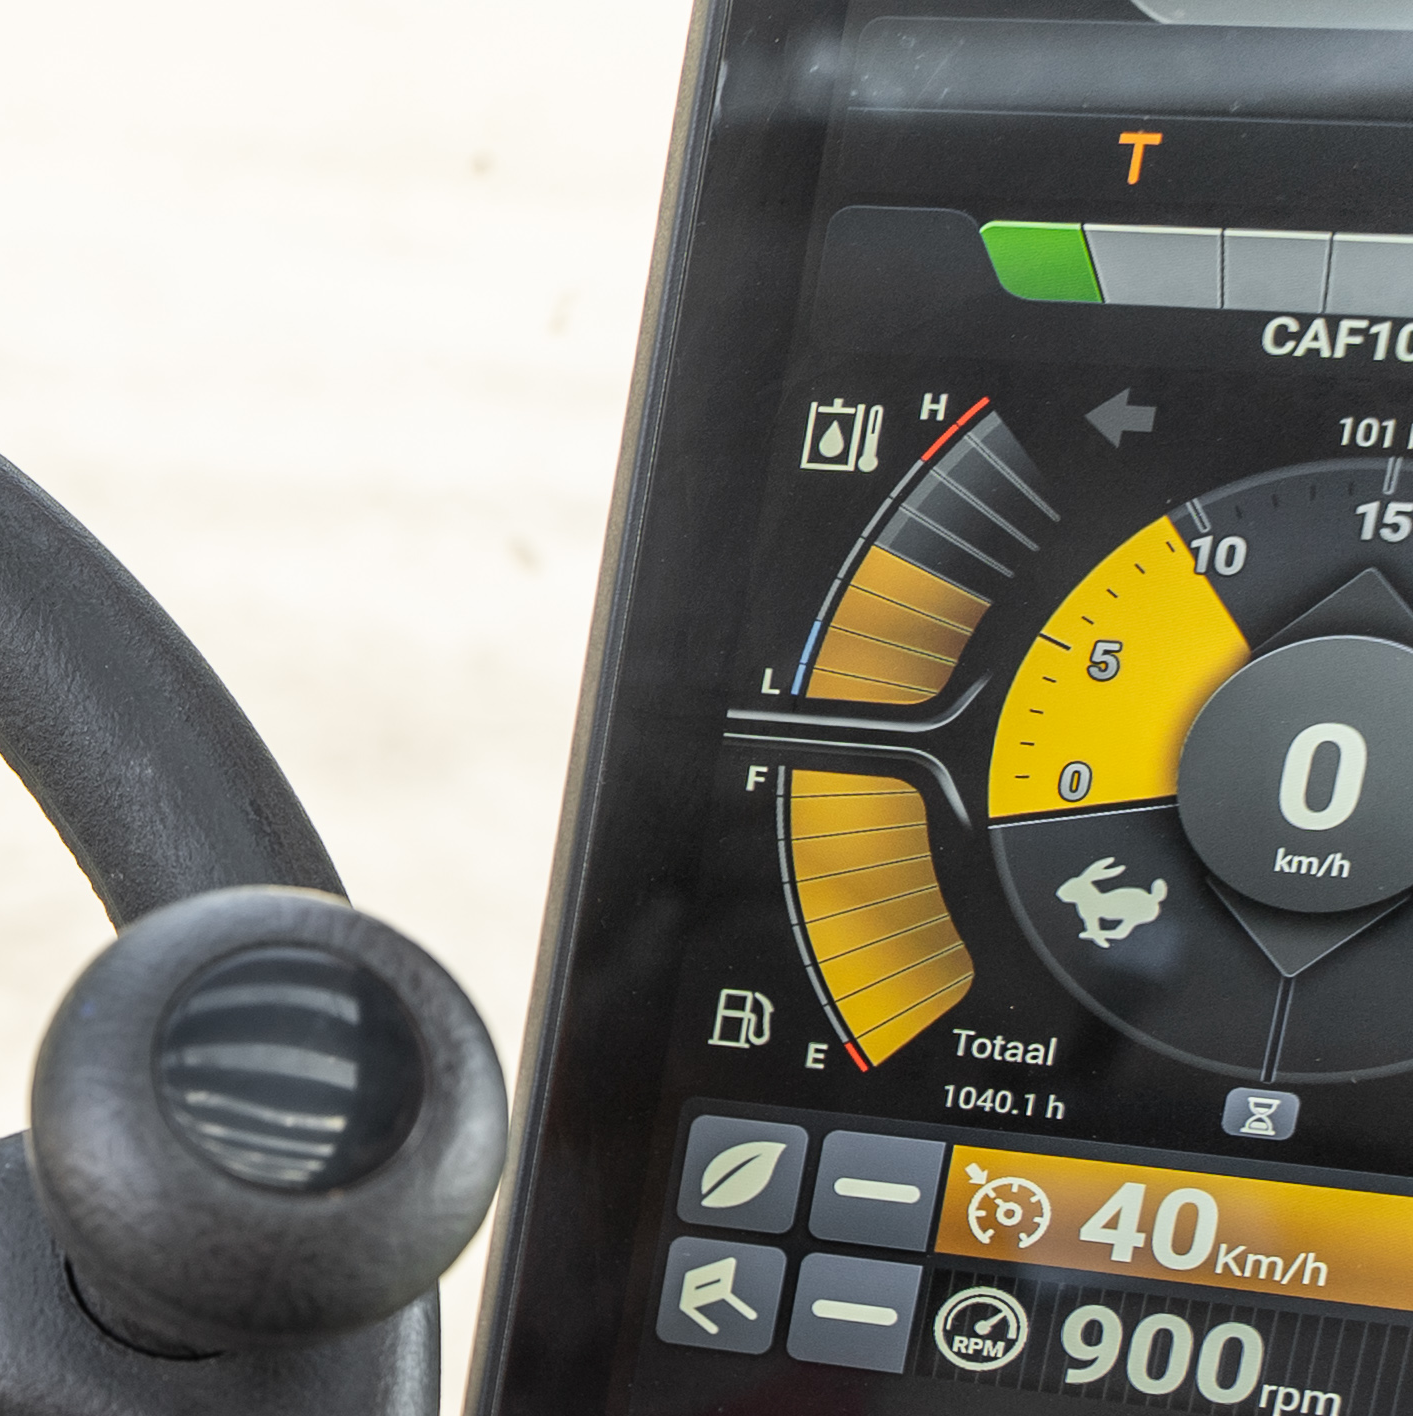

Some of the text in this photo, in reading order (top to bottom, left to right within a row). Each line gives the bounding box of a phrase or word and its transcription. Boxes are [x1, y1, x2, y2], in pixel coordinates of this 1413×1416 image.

[1118, 131, 1163, 185] T
[919, 392, 949, 421] H
[1338, 416, 1397, 449] 101
[1354, 500, 1413, 543] 15
[1190, 534, 1248, 577] 10
[1087, 640, 1123, 682] 5
[760, 667, 781, 696] L
[745, 765, 769, 791] F
[1058, 761, 1093, 803] 0
[1278, 722, 1368, 832] 0
[1274, 847, 1352, 879] km/h
[804, 1042, 829, 1070] E
[951, 1028, 1059, 1067] Totaal
[943, 1084, 1066, 1120] 1040.1 h
[1078, 1181, 1329, 1289] 40 Km/h
[952, 1335, 1006, 1358] RPM
[1061, 1303, 1264, 1405] 900
